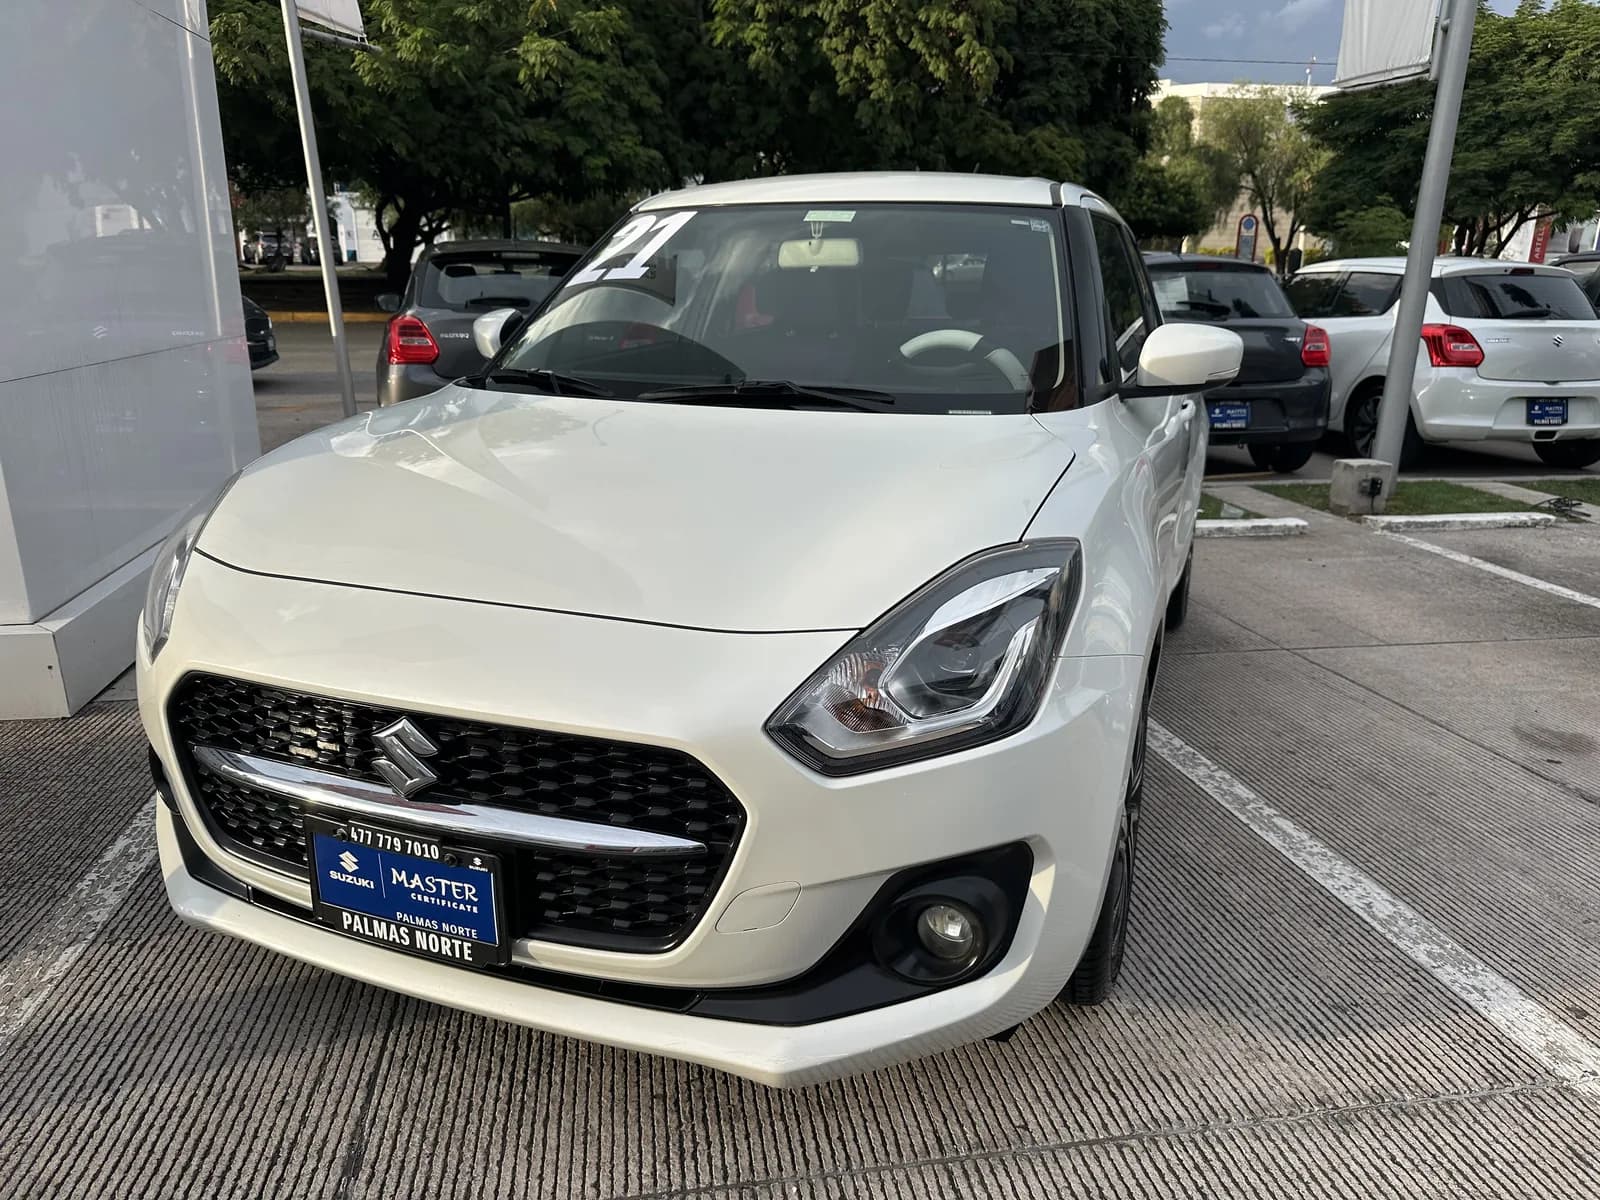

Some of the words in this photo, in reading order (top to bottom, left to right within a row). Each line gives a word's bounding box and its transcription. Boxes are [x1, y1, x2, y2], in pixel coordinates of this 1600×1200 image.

[564, 211, 698, 288] 21
[351, 827, 373, 846] 477
[376, 833, 401, 852] 779
[404, 839, 440, 860] 7010
[329, 870, 375, 889] SUZUKI
[390, 867, 478, 902] MASTER
[410, 892, 479, 913] CERTIFICATE
[341, 911, 410, 946] PALMAS
[415, 930, 473, 961] NORTE
[396, 911, 439, 930] PALMAS
[442, 922, 478, 939] NORTE
